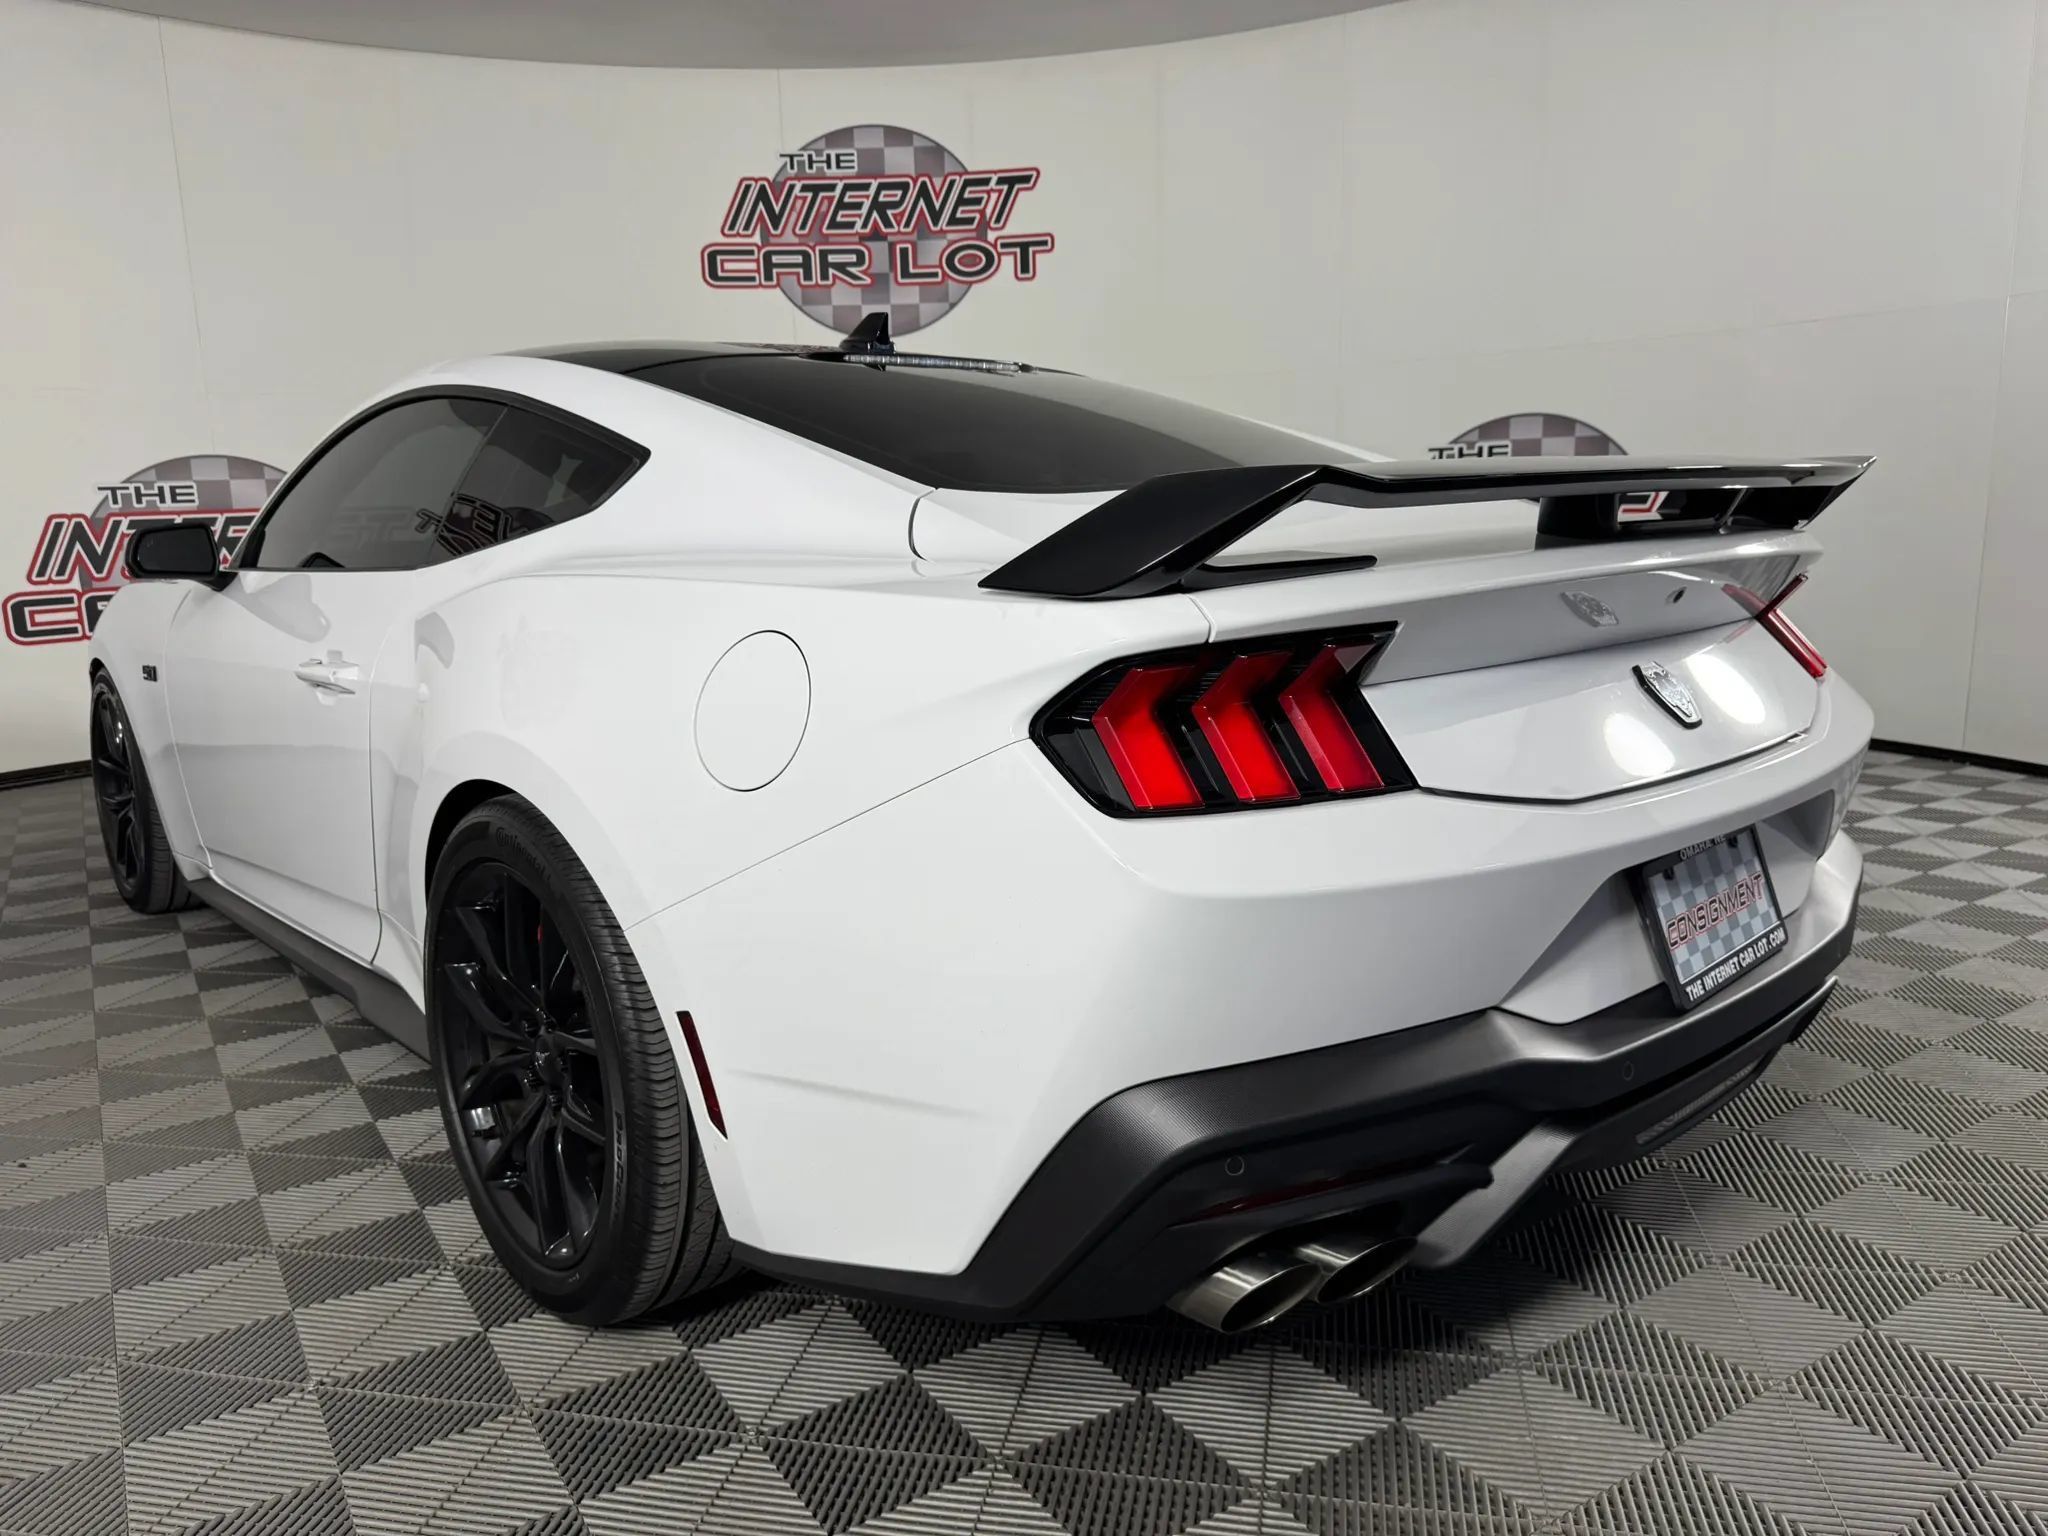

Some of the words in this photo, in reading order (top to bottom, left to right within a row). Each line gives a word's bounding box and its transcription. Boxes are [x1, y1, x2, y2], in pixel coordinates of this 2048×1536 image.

[779, 151, 857, 171] THE
[722, 168, 1040, 236] INTERNET
[702, 243, 873, 288] CAR
[894, 234, 1054, 286] LOT
[97, 483, 198, 507] THE
[1666, 873, 1763, 947] CONSIGNMENT
[1686, 983, 1705, 1002] THE
[1704, 959, 1740, 991] INTERNET
[1739, 947, 1756, 968] CAR
